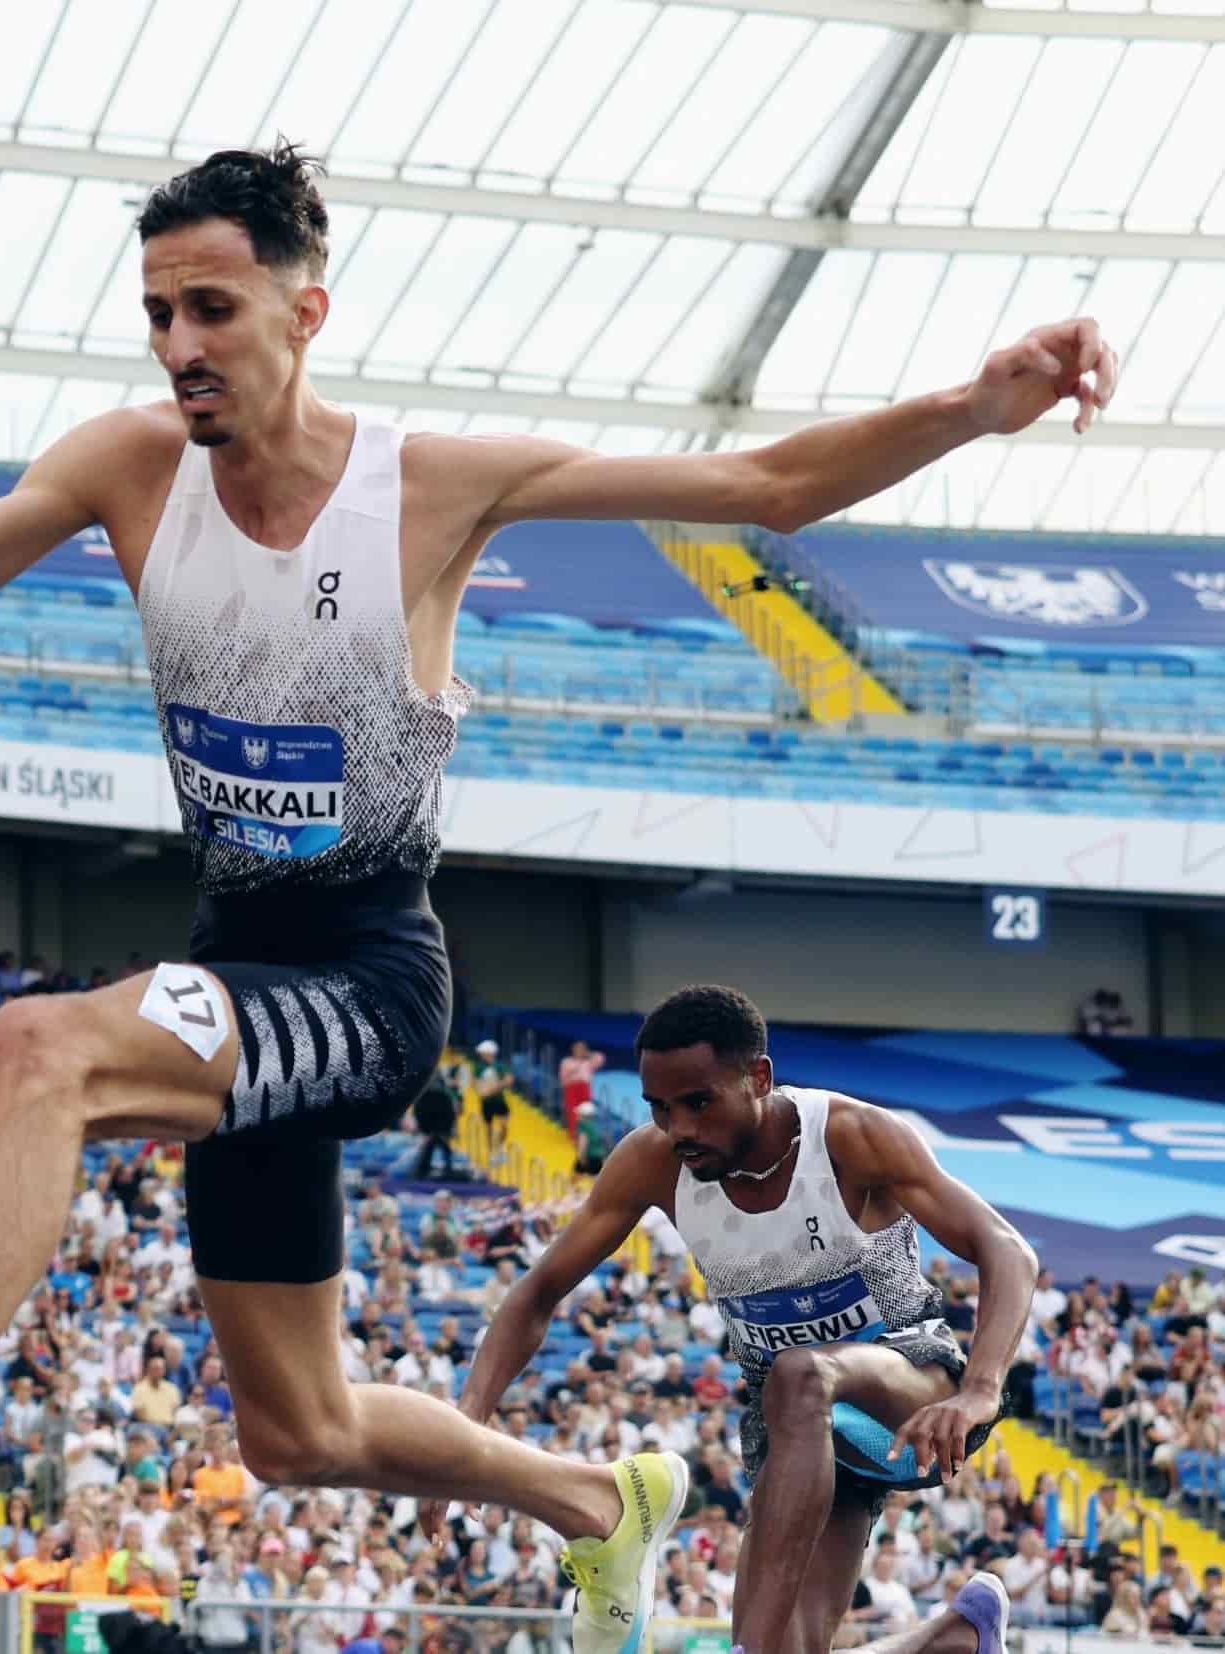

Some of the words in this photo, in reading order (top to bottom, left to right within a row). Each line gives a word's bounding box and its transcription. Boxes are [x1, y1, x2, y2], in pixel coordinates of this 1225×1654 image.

[18, 760, 115, 808] ŚLĄSKI
[213, 818, 293, 855] SILESIA
[992, 896, 1040, 940] 23
[163, 980, 216, 1029] 17
[743, 1303, 869, 1351] FIREWU
